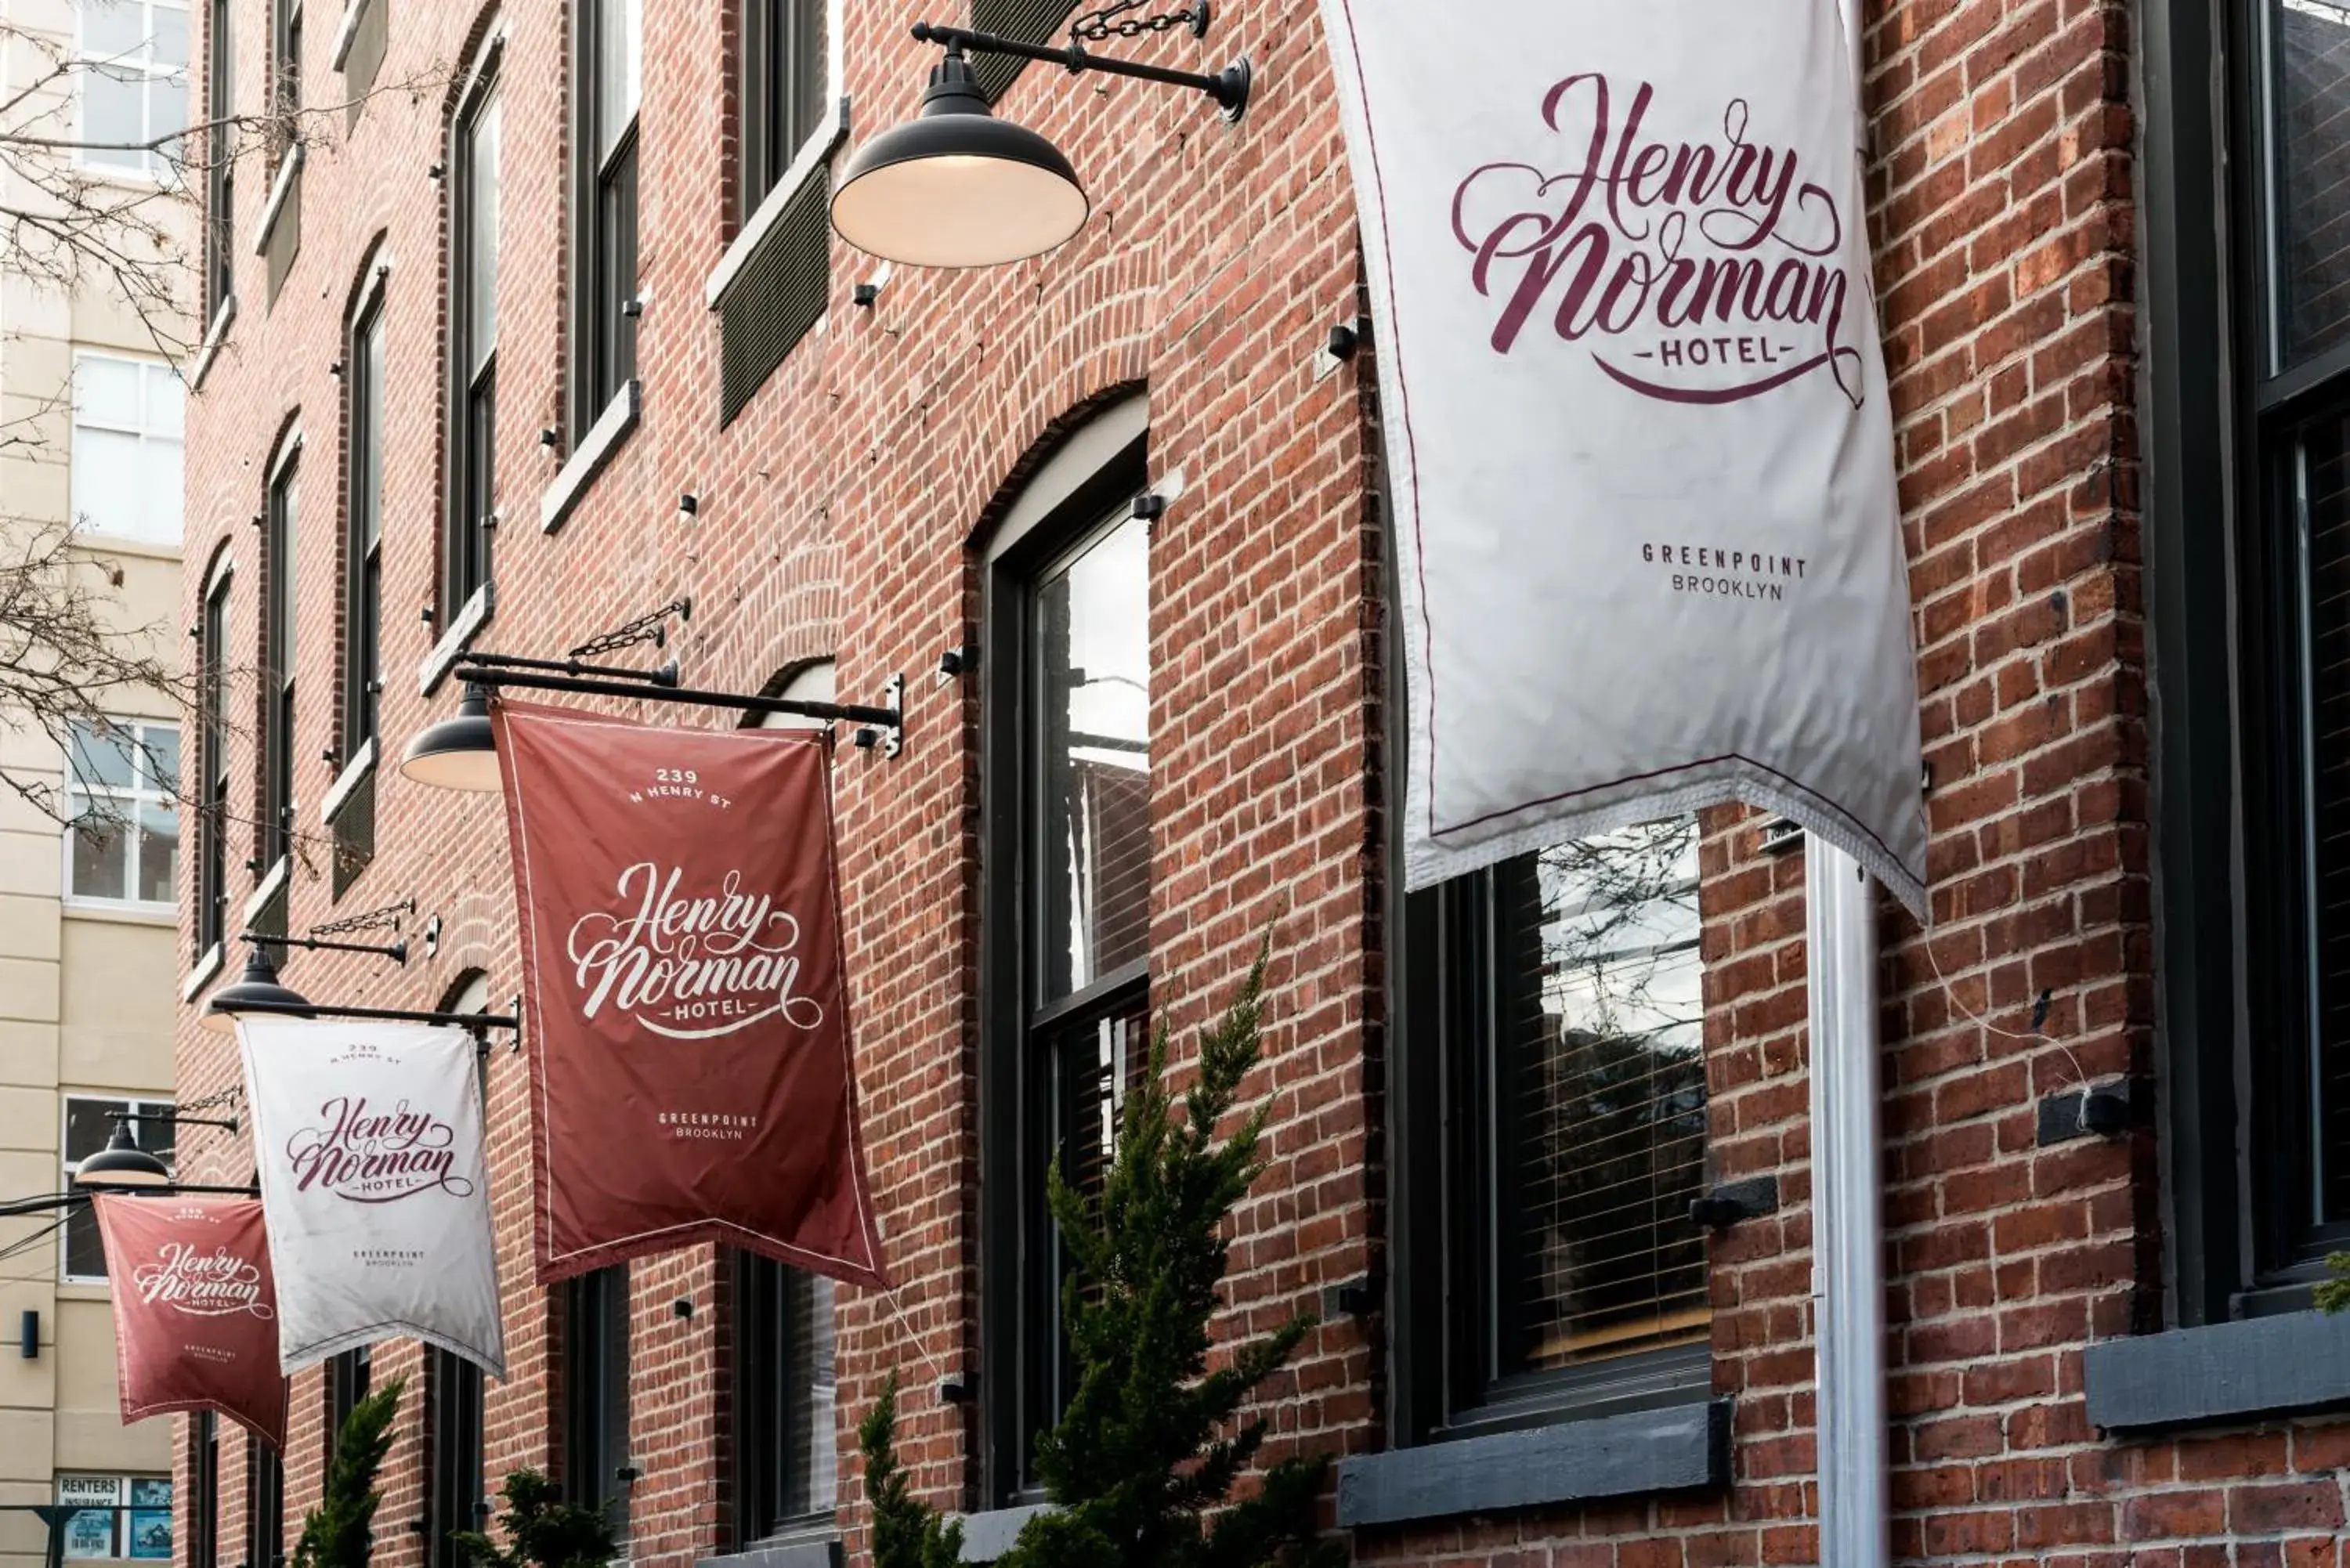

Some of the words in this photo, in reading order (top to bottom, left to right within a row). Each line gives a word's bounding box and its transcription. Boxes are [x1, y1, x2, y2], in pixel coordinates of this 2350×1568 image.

[1452, 73, 1841, 257] Henry
[1472, 211, 1864, 410] Norman
[1642, 543, 1806, 578] GREENPOINT
[1672, 574, 1784, 601] BROOKLYN
[647, 786, 703, 799] HENRY
[710, 794, 731, 808] ST
[656, 768, 697, 784] 239
[568, 862, 800, 967] Henry
[576, 935, 823, 1039] Norman
[287, 1097, 454, 1161] Henry
[659, 1113, 756, 1128] GREENPOINT
[676, 1127, 743, 1140] BROOKLYN
[291, 1139, 474, 1204] Norman
[133, 1242, 260, 1288] Henry
[138, 1273, 273, 1320] Norman
[62, 1479, 116, 1494] RENTERS
